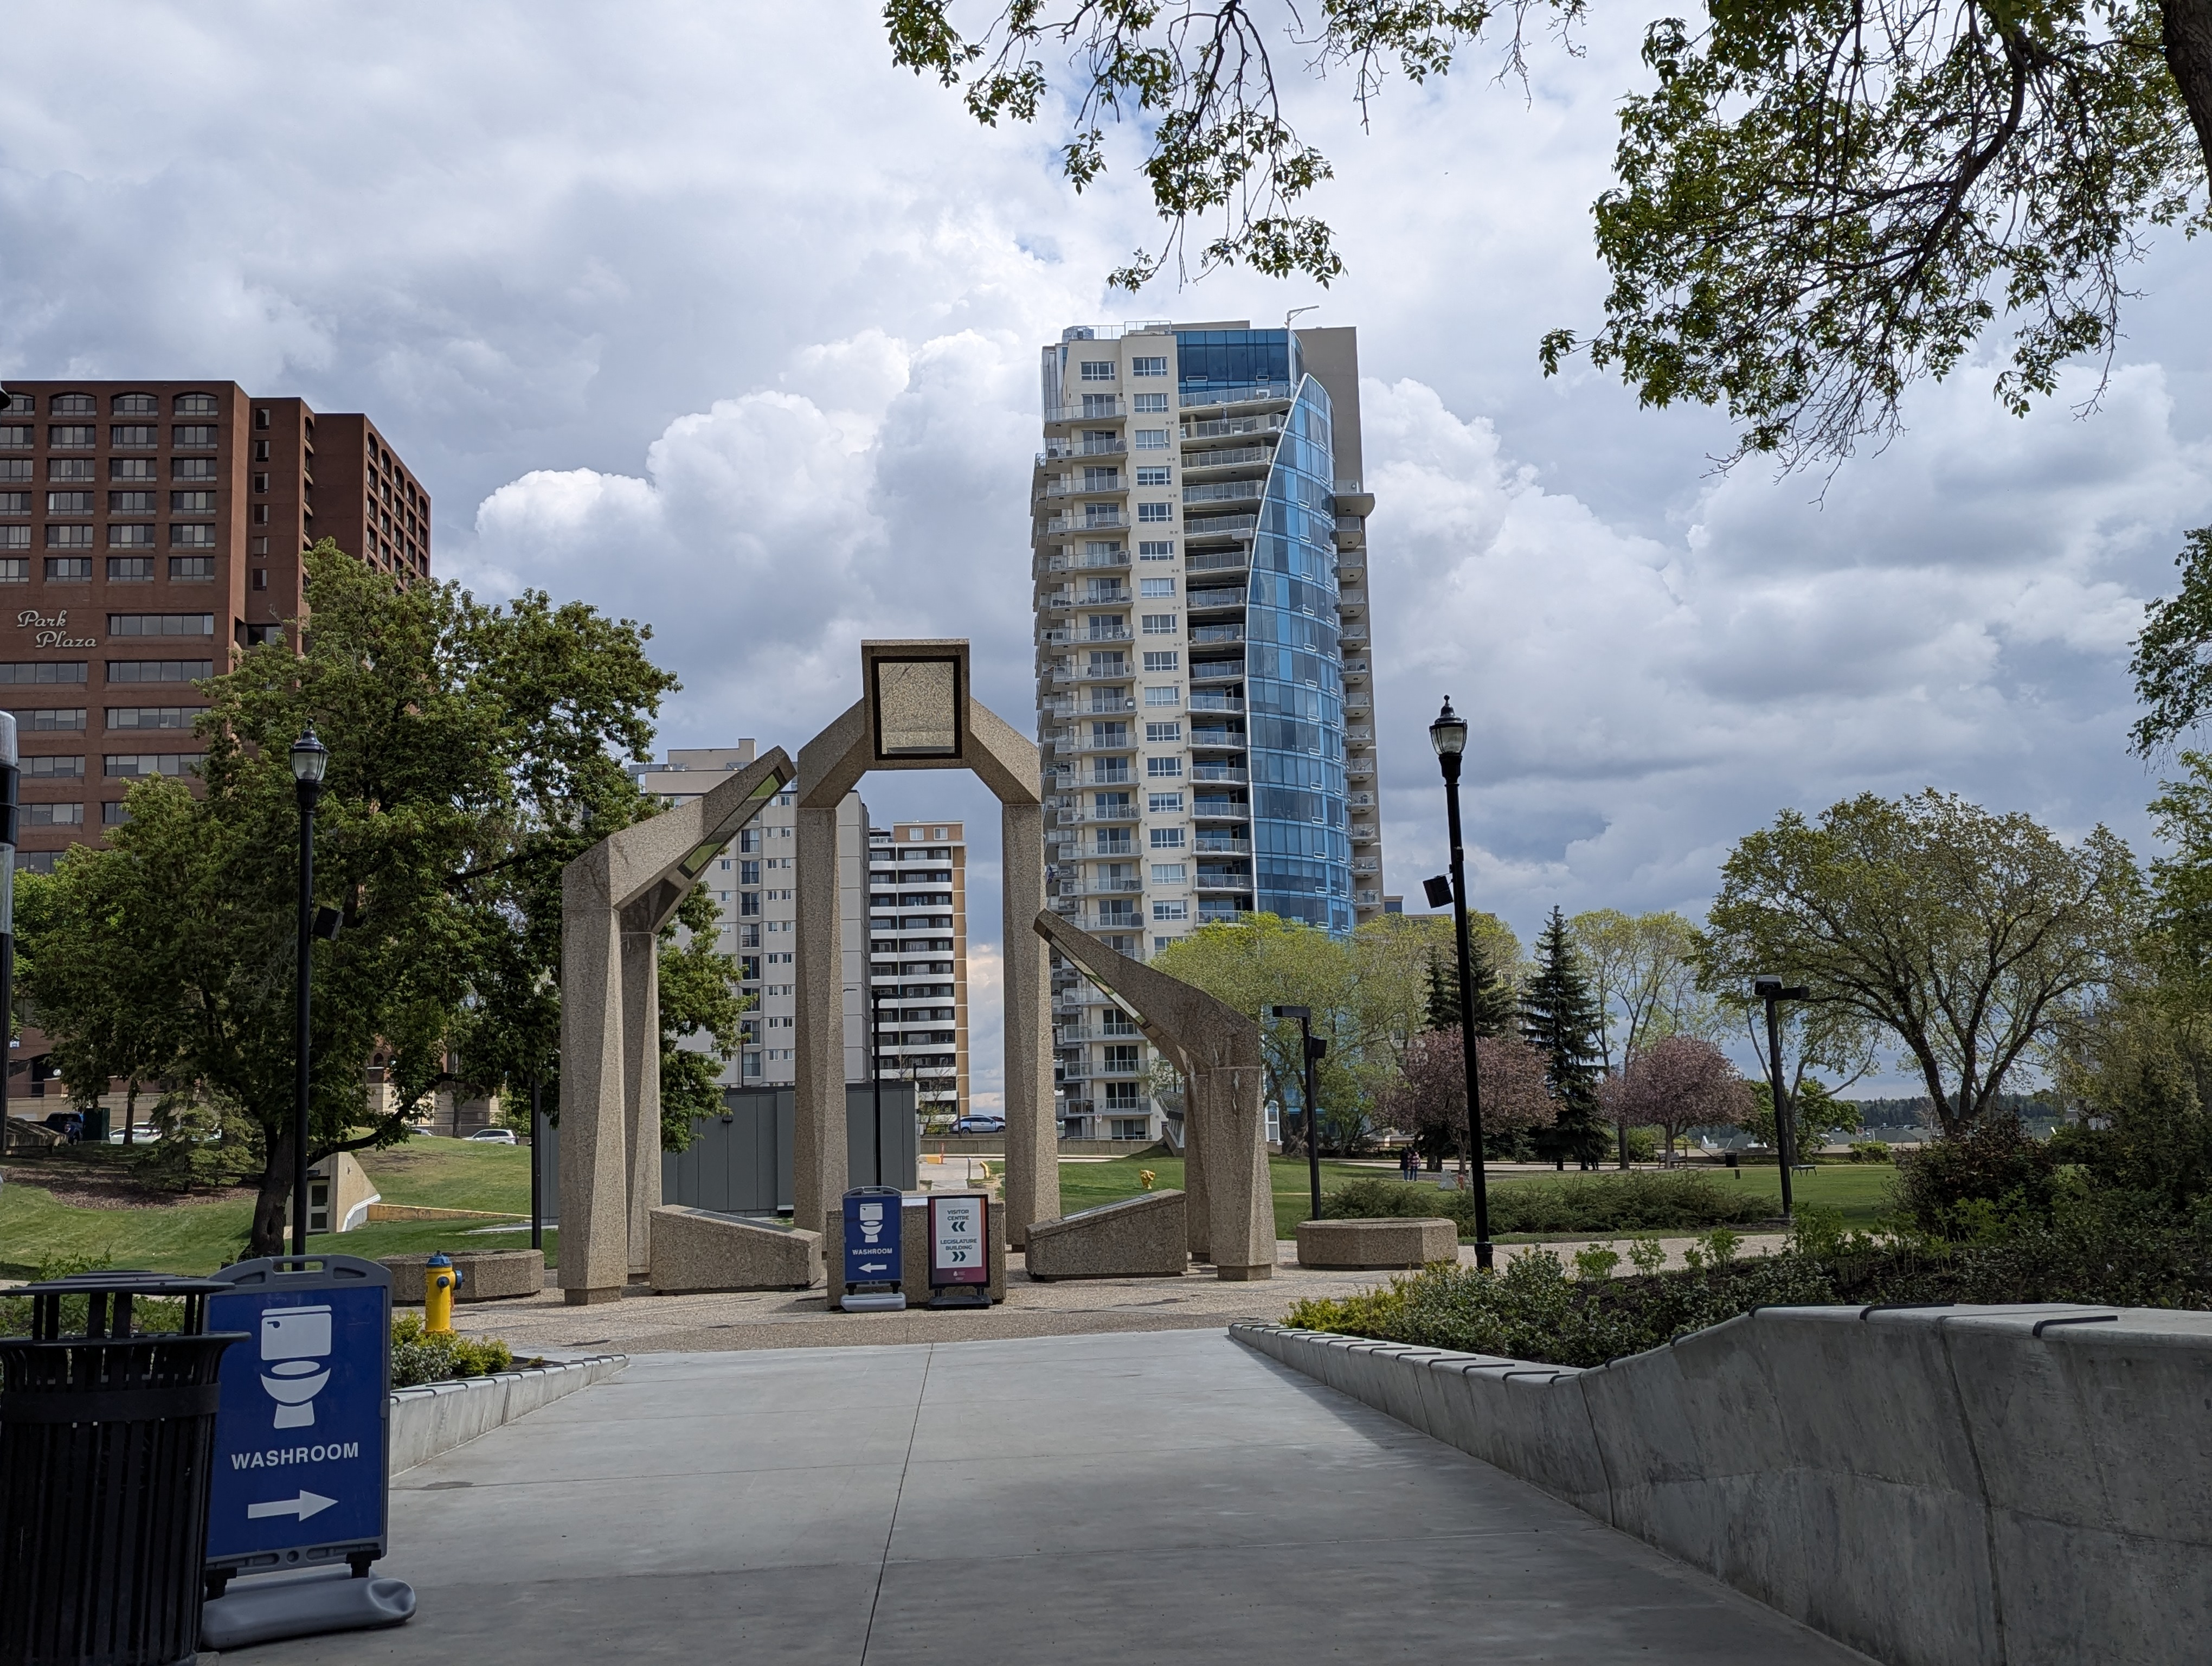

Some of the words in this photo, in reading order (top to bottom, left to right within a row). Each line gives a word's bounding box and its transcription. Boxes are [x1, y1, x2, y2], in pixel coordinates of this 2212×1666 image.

[17, 610, 67, 627] Park
[35, 630, 97, 648] Plaza
[231, 1441, 358, 1470] WASHROOM
